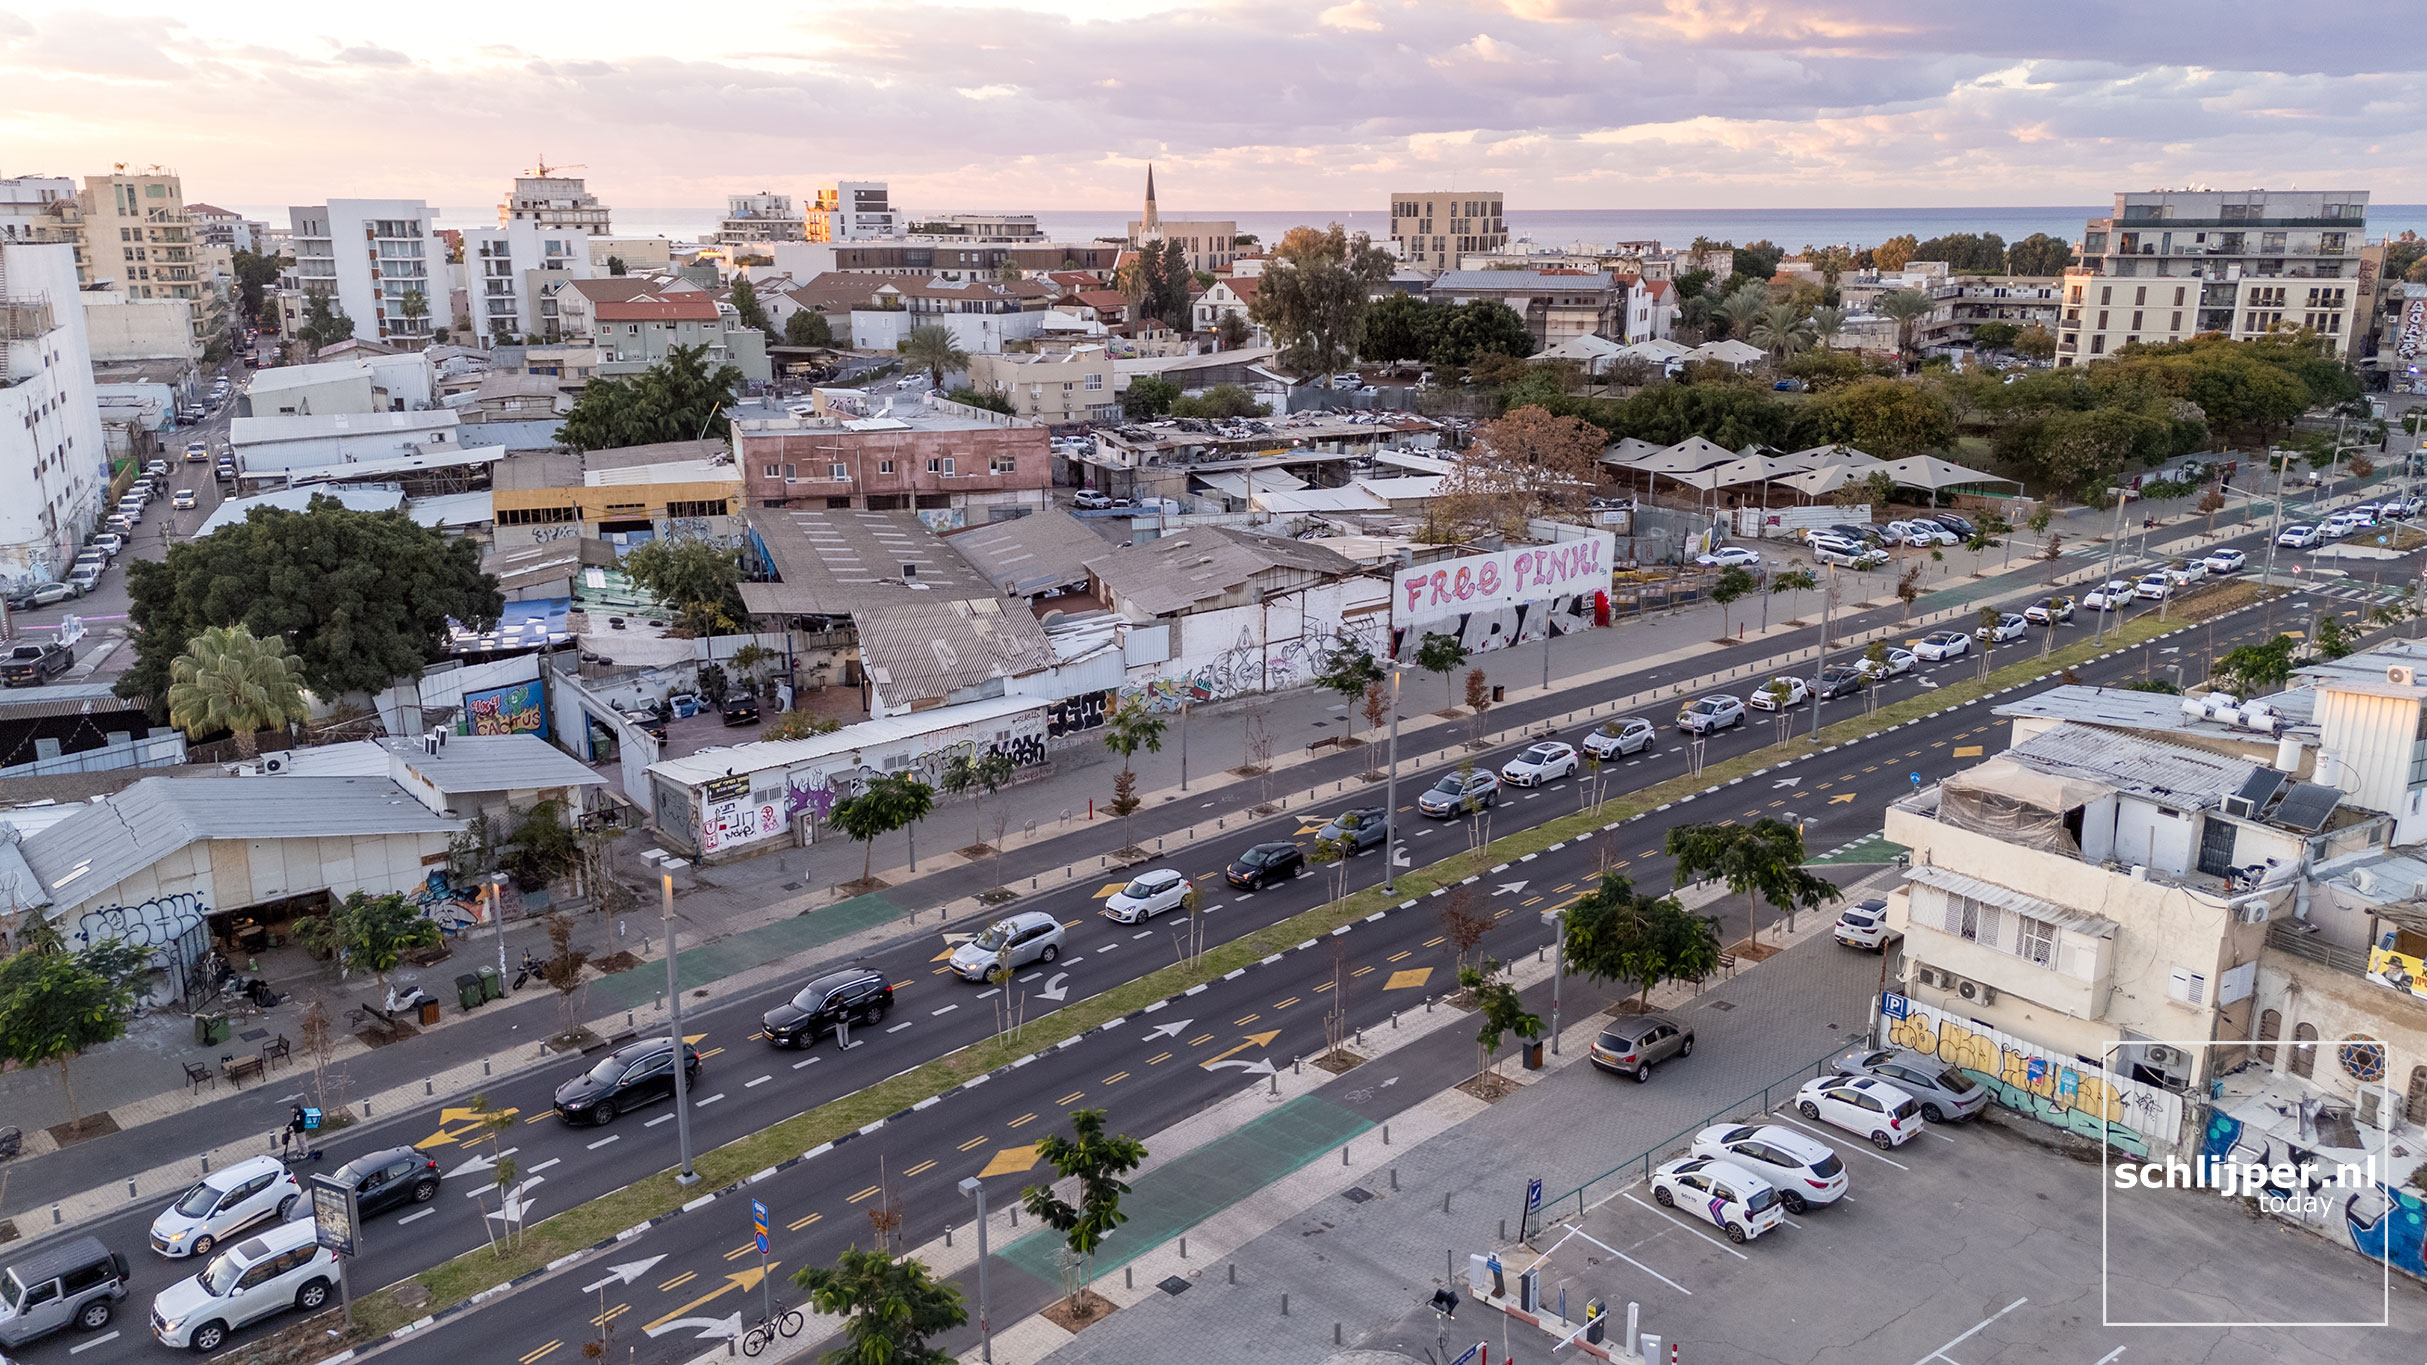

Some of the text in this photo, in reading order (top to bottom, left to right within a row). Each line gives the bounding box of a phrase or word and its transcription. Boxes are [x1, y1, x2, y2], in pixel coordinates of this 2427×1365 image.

[1513, 539, 1601, 592] PINK!
[476, 711, 541, 736] CACTUS
[1890, 997, 1901, 1010] P
